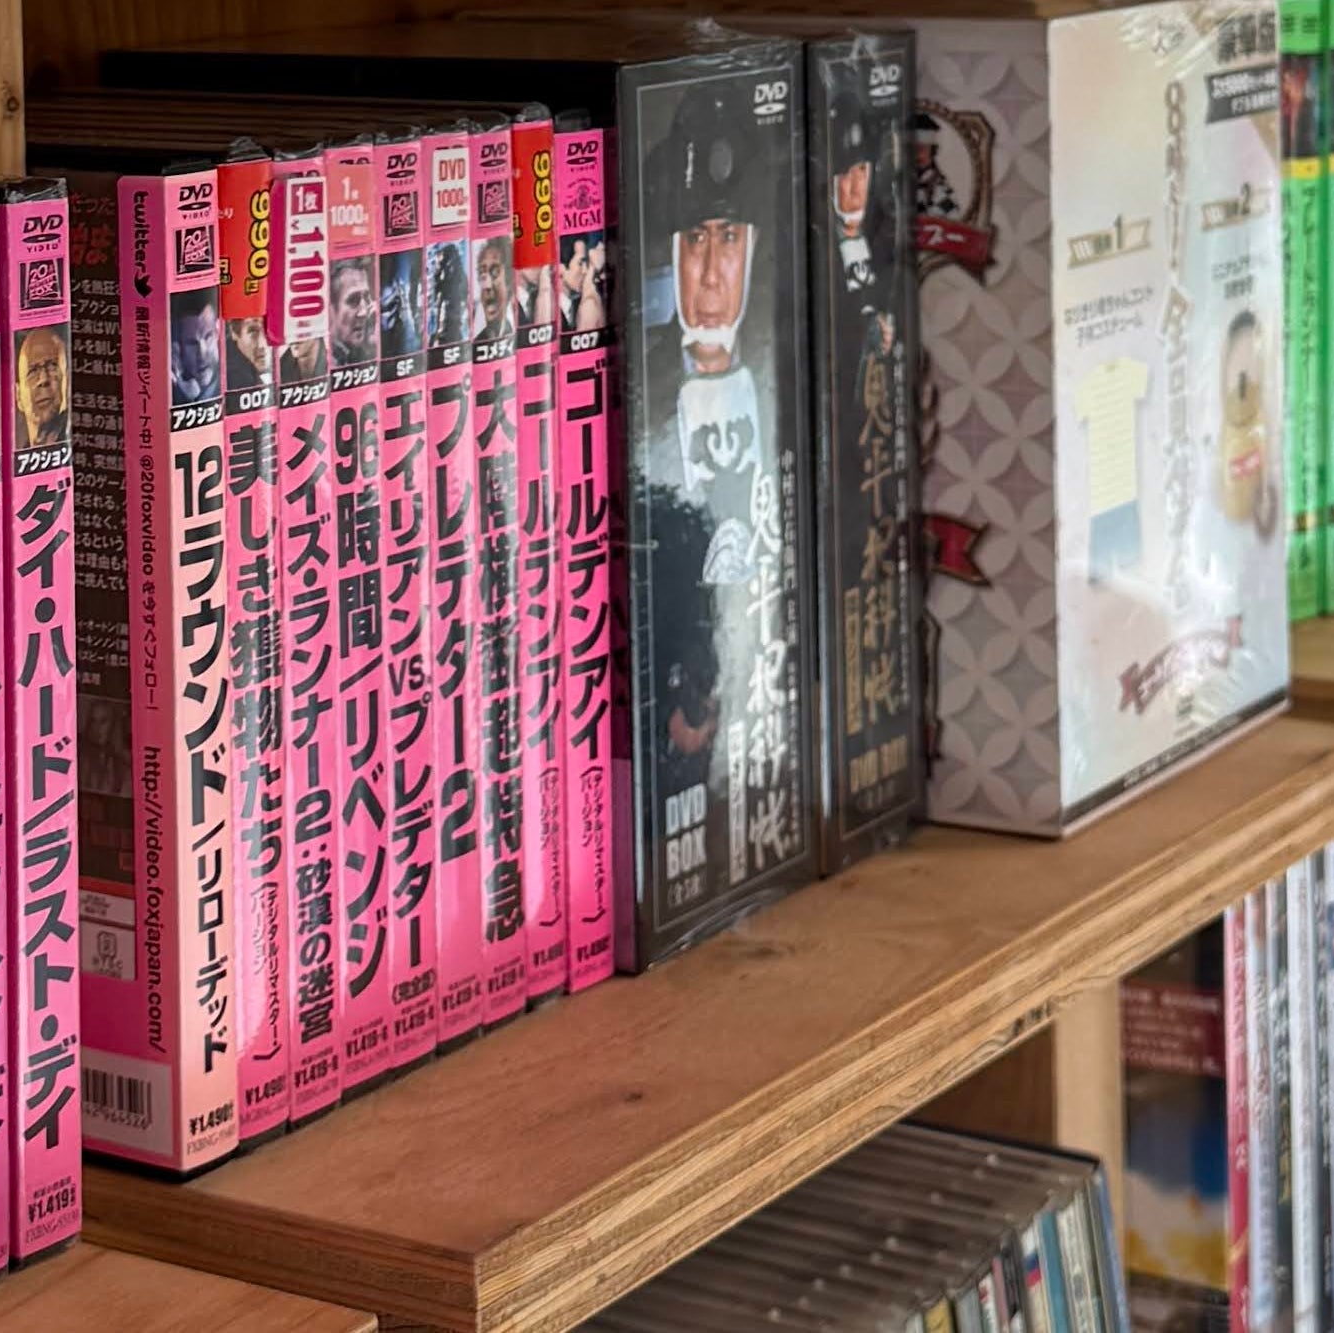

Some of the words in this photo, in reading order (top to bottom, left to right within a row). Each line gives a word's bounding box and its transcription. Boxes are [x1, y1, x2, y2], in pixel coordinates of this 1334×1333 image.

[869, 63, 902, 87] DVD
[753, 80, 790, 105] DVD
[480, 141, 508, 160] DVD
[566, 140, 599, 157] DVD
[387, 152, 418, 171] DVD
[439, 157, 466, 182] DVD
[179, 183, 213, 202] DVD
[23, 214, 63, 234] DVD
[563, 209, 602, 230] MGM
[133, 190, 150, 274] twitter
[528, 326, 553, 345] 007
[570, 332, 599, 351] 007
[443, 348, 460, 365] SF
[476, 338, 514, 362] コメディ
[332, 365, 378, 391] アクション
[396, 360, 414, 378] SF
[239, 389, 270, 411] 007
[281, 381, 328, 408] アクション
[172, 404, 222, 431] アクション
[17, 445, 72, 473] アクション
[566, 357, 609, 760] ゴールデンアイ
[429, 376, 477, 864] プレデター2
[665, 783, 708, 837] DVD
[665, 824, 708, 881] BOX
[141, 745, 166, 1053] http://video.foxjapan.com/
